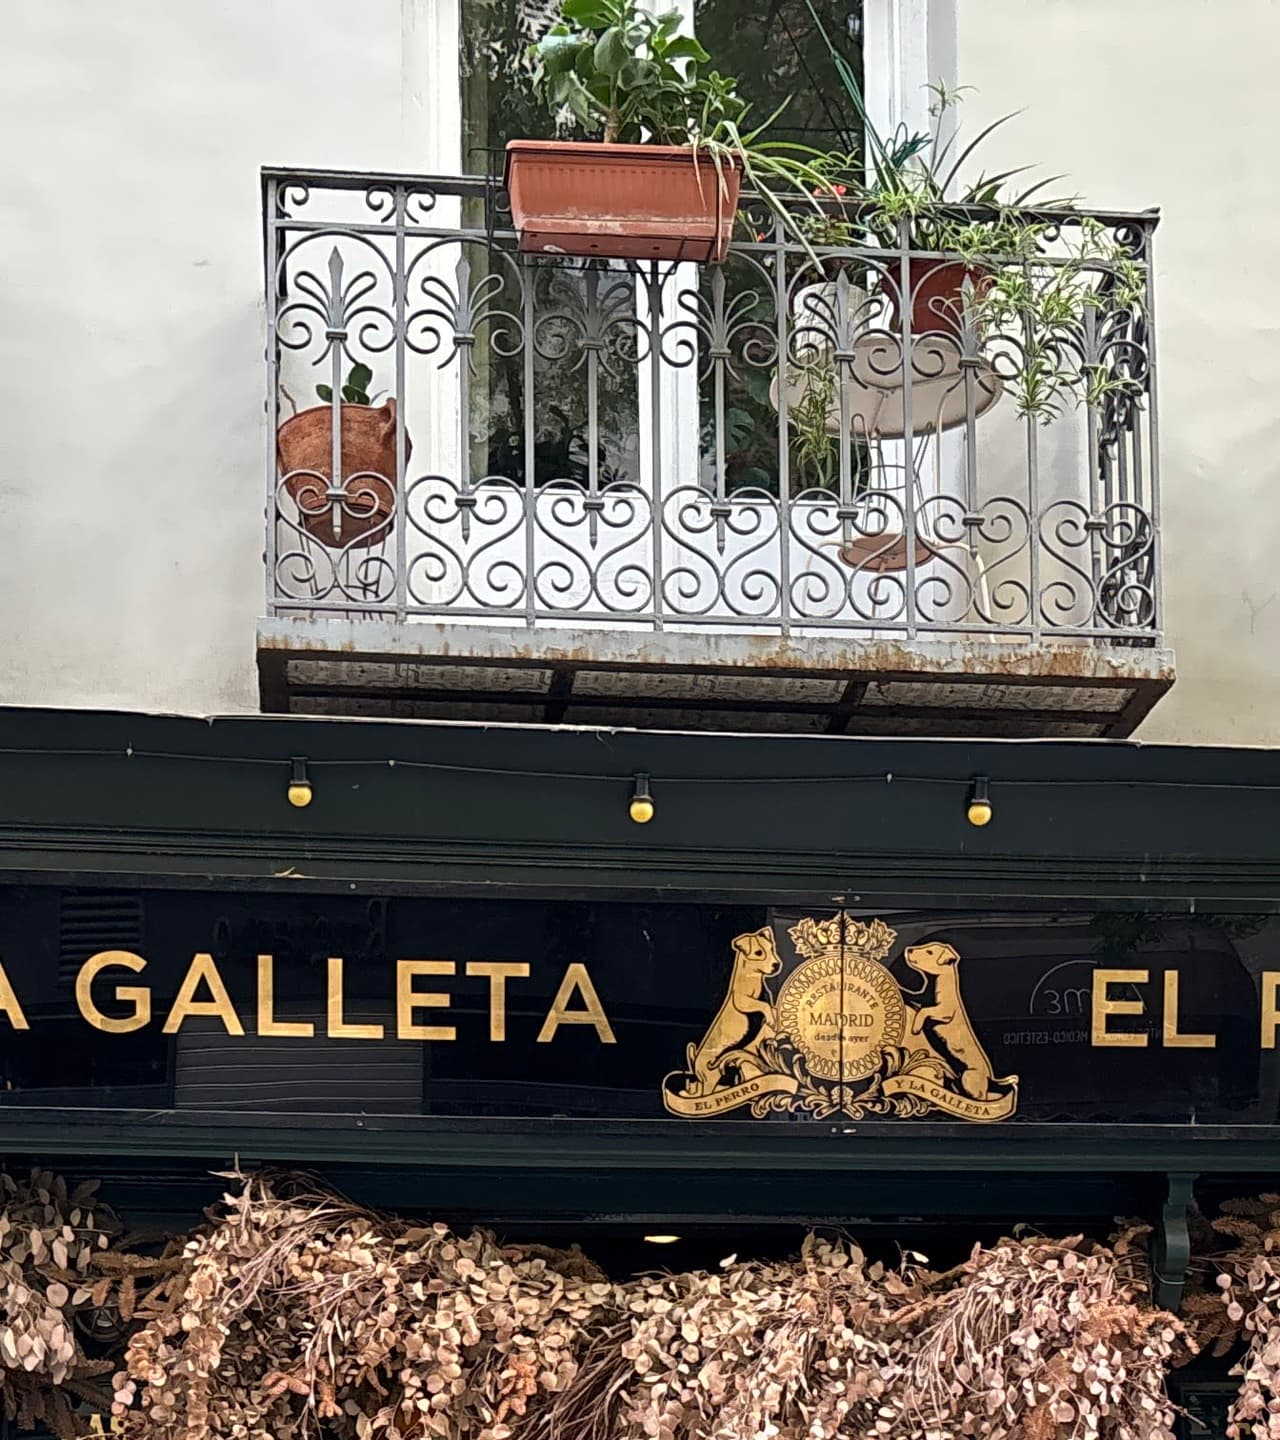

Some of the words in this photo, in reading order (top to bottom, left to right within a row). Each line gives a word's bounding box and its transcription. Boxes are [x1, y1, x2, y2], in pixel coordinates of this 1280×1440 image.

[76, 951, 616, 1043] GALLETA
[1092, 969, 1215, 1047] EL
[809, 1013, 874, 1028] MADRID
[694, 1102, 713, 1111] EL
[715, 1082, 760, 1107] PERRO
[895, 1079, 904, 1089] Y
[909, 1081, 926, 1093] LA
[930, 1088, 991, 1116] GALLETA
